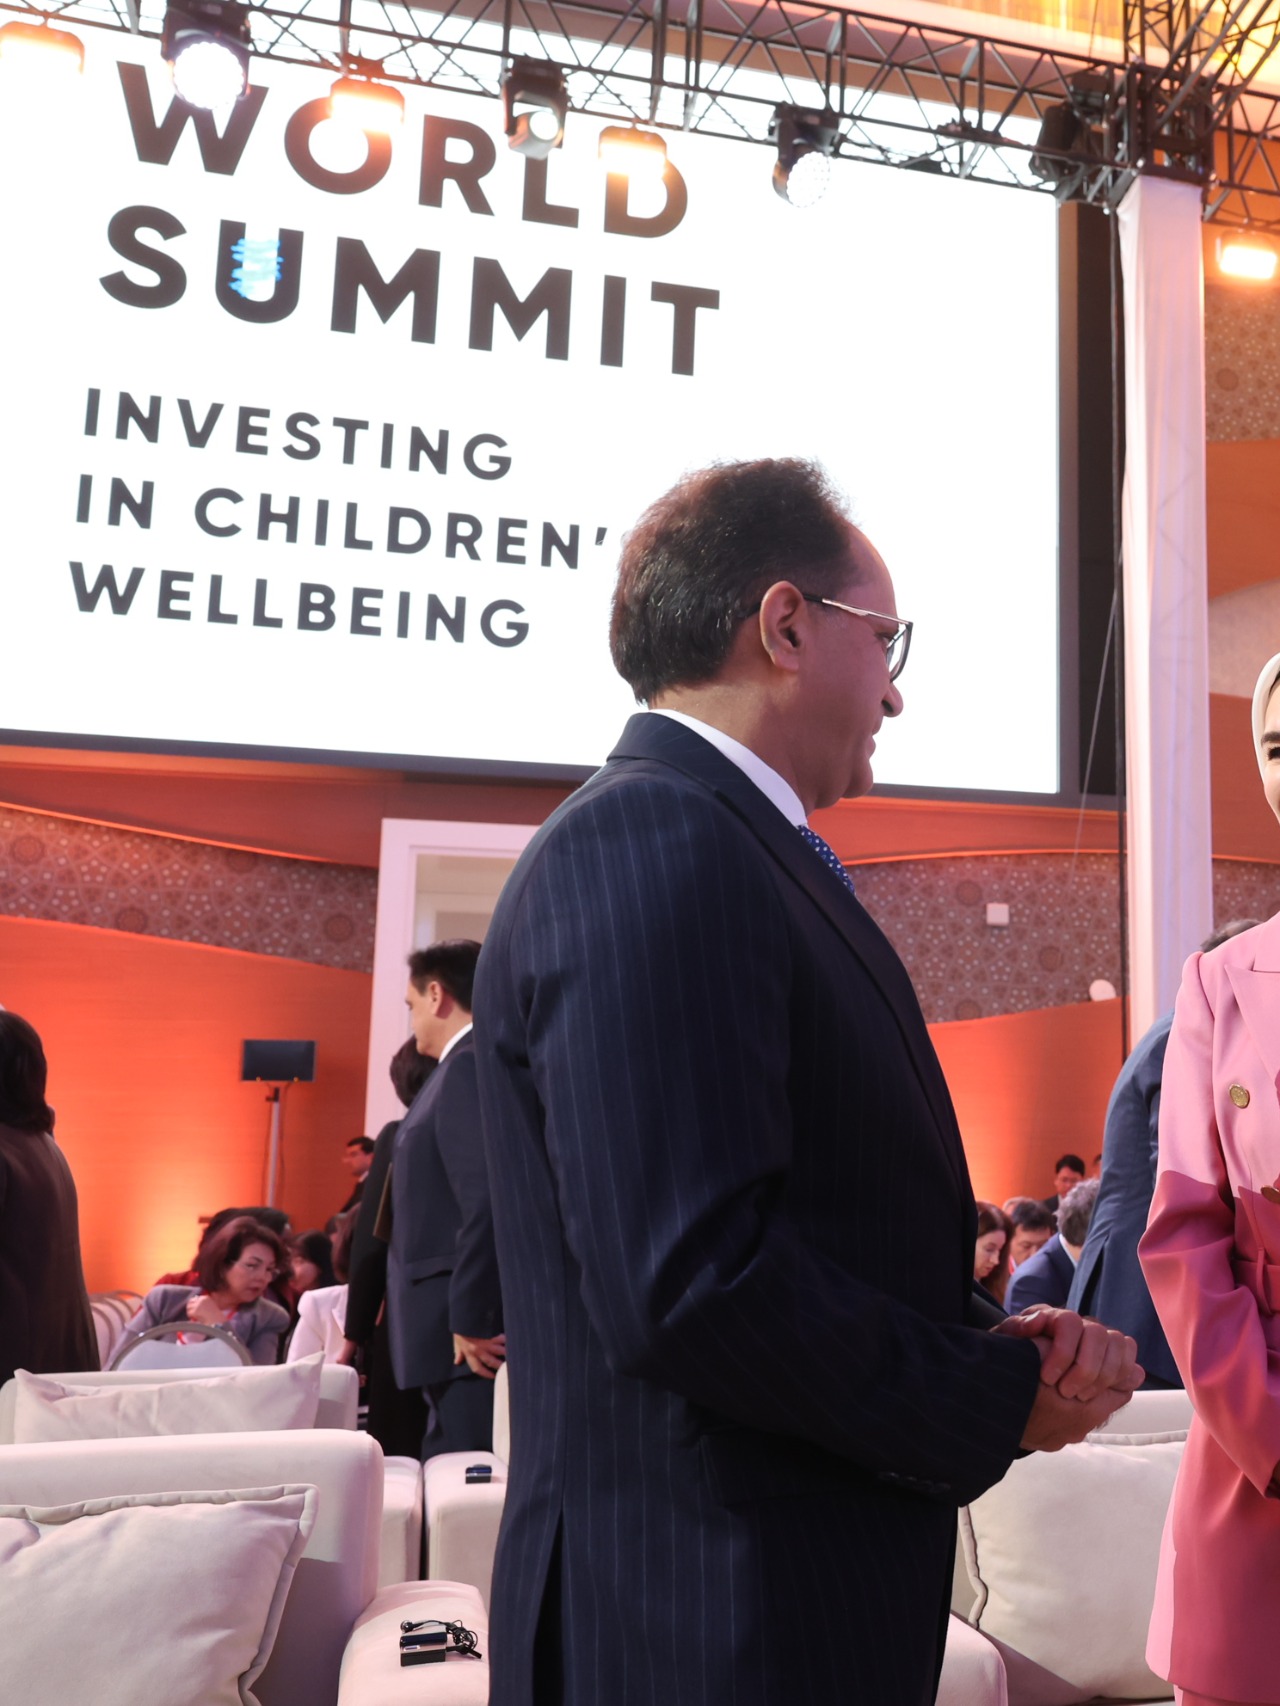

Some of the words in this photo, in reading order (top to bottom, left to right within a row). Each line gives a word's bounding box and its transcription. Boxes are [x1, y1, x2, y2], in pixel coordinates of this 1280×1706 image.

[116, 60, 688, 239] WORLD
[99, 205, 720, 377] SUMMIT
[84, 388, 512, 481] INVESTING
[76, 474, 155, 530] IN
[194, 487, 608, 570] CHILDREN'
[69, 561, 530, 648] WELLBEING
